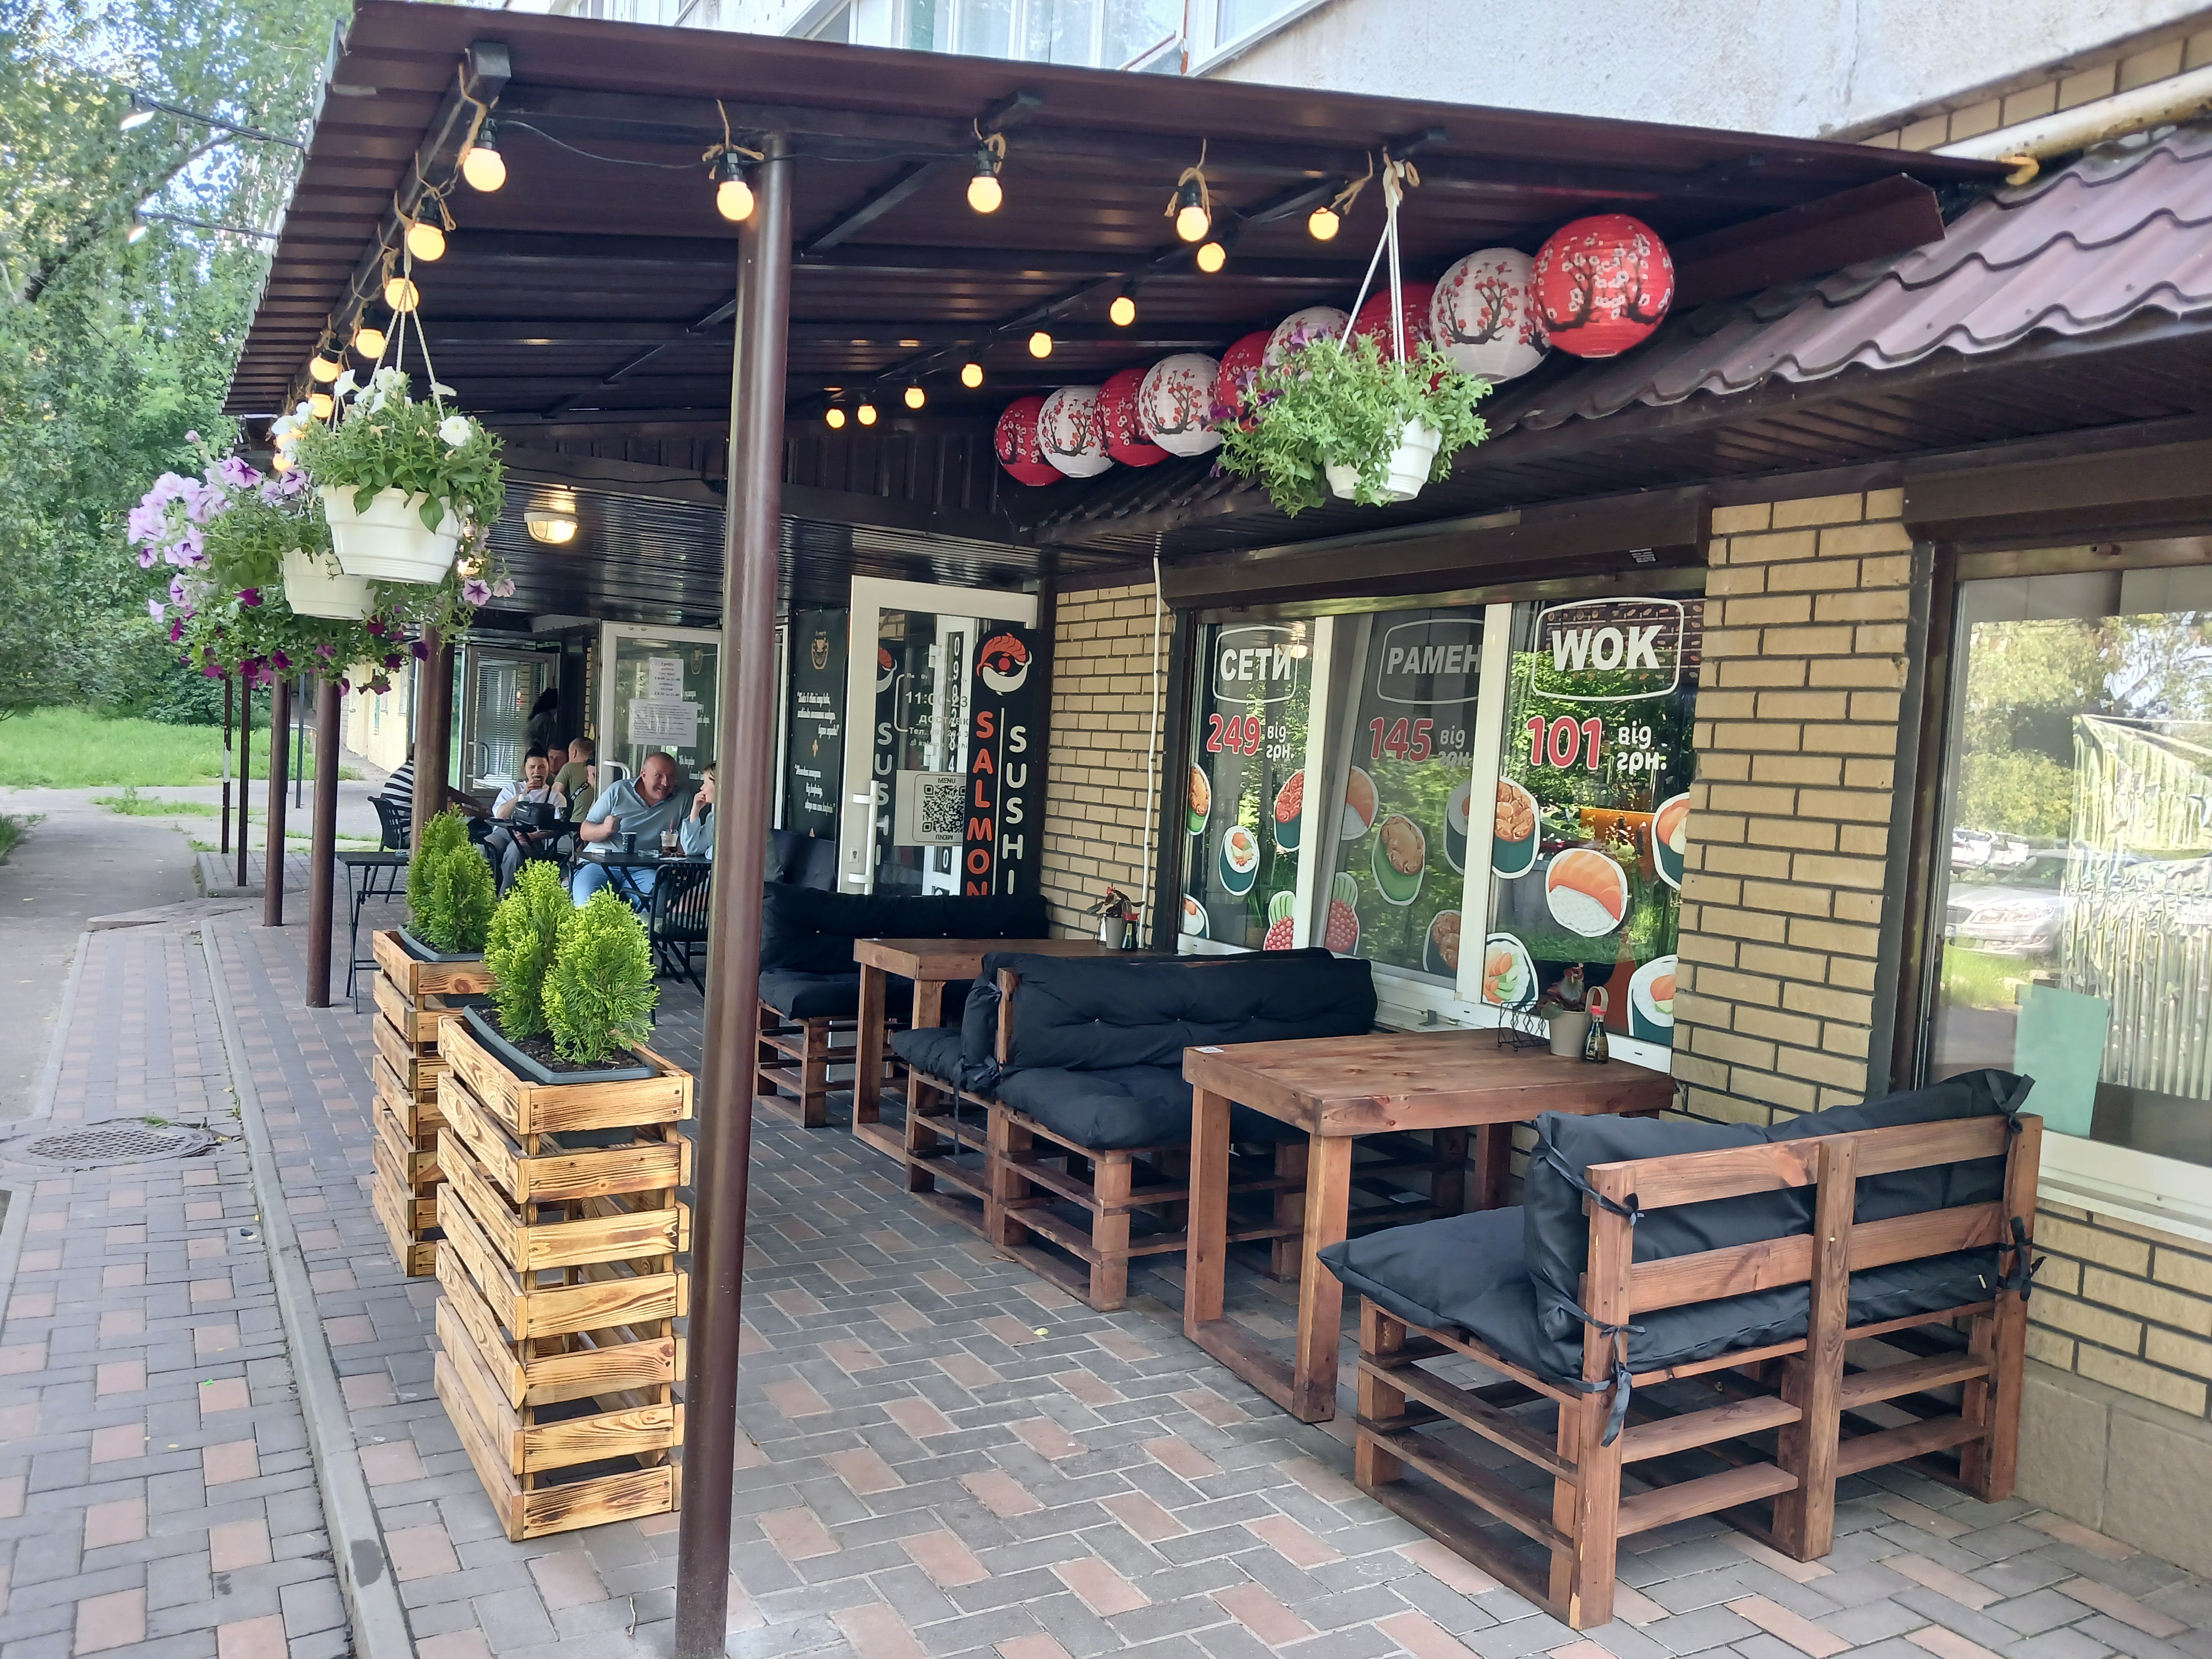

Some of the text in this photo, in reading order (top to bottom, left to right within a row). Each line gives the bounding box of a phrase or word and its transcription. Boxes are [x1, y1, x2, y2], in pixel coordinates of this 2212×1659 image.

[1220, 647, 1291, 681] СЕТИ
[1386, 644, 1483, 674] РАМЕН
[1552, 625, 1663, 671] WOK
[1206, 713, 1287, 756] 249 від
[1266, 744, 1295, 762] грн.
[1369, 717, 1465, 762] 145 від
[1527, 715, 1651, 769] 101 від
[1617, 752, 1667, 775] грн.
[967, 711, 994, 896] SALMON
[1002, 725, 1027, 895] SUSHI
